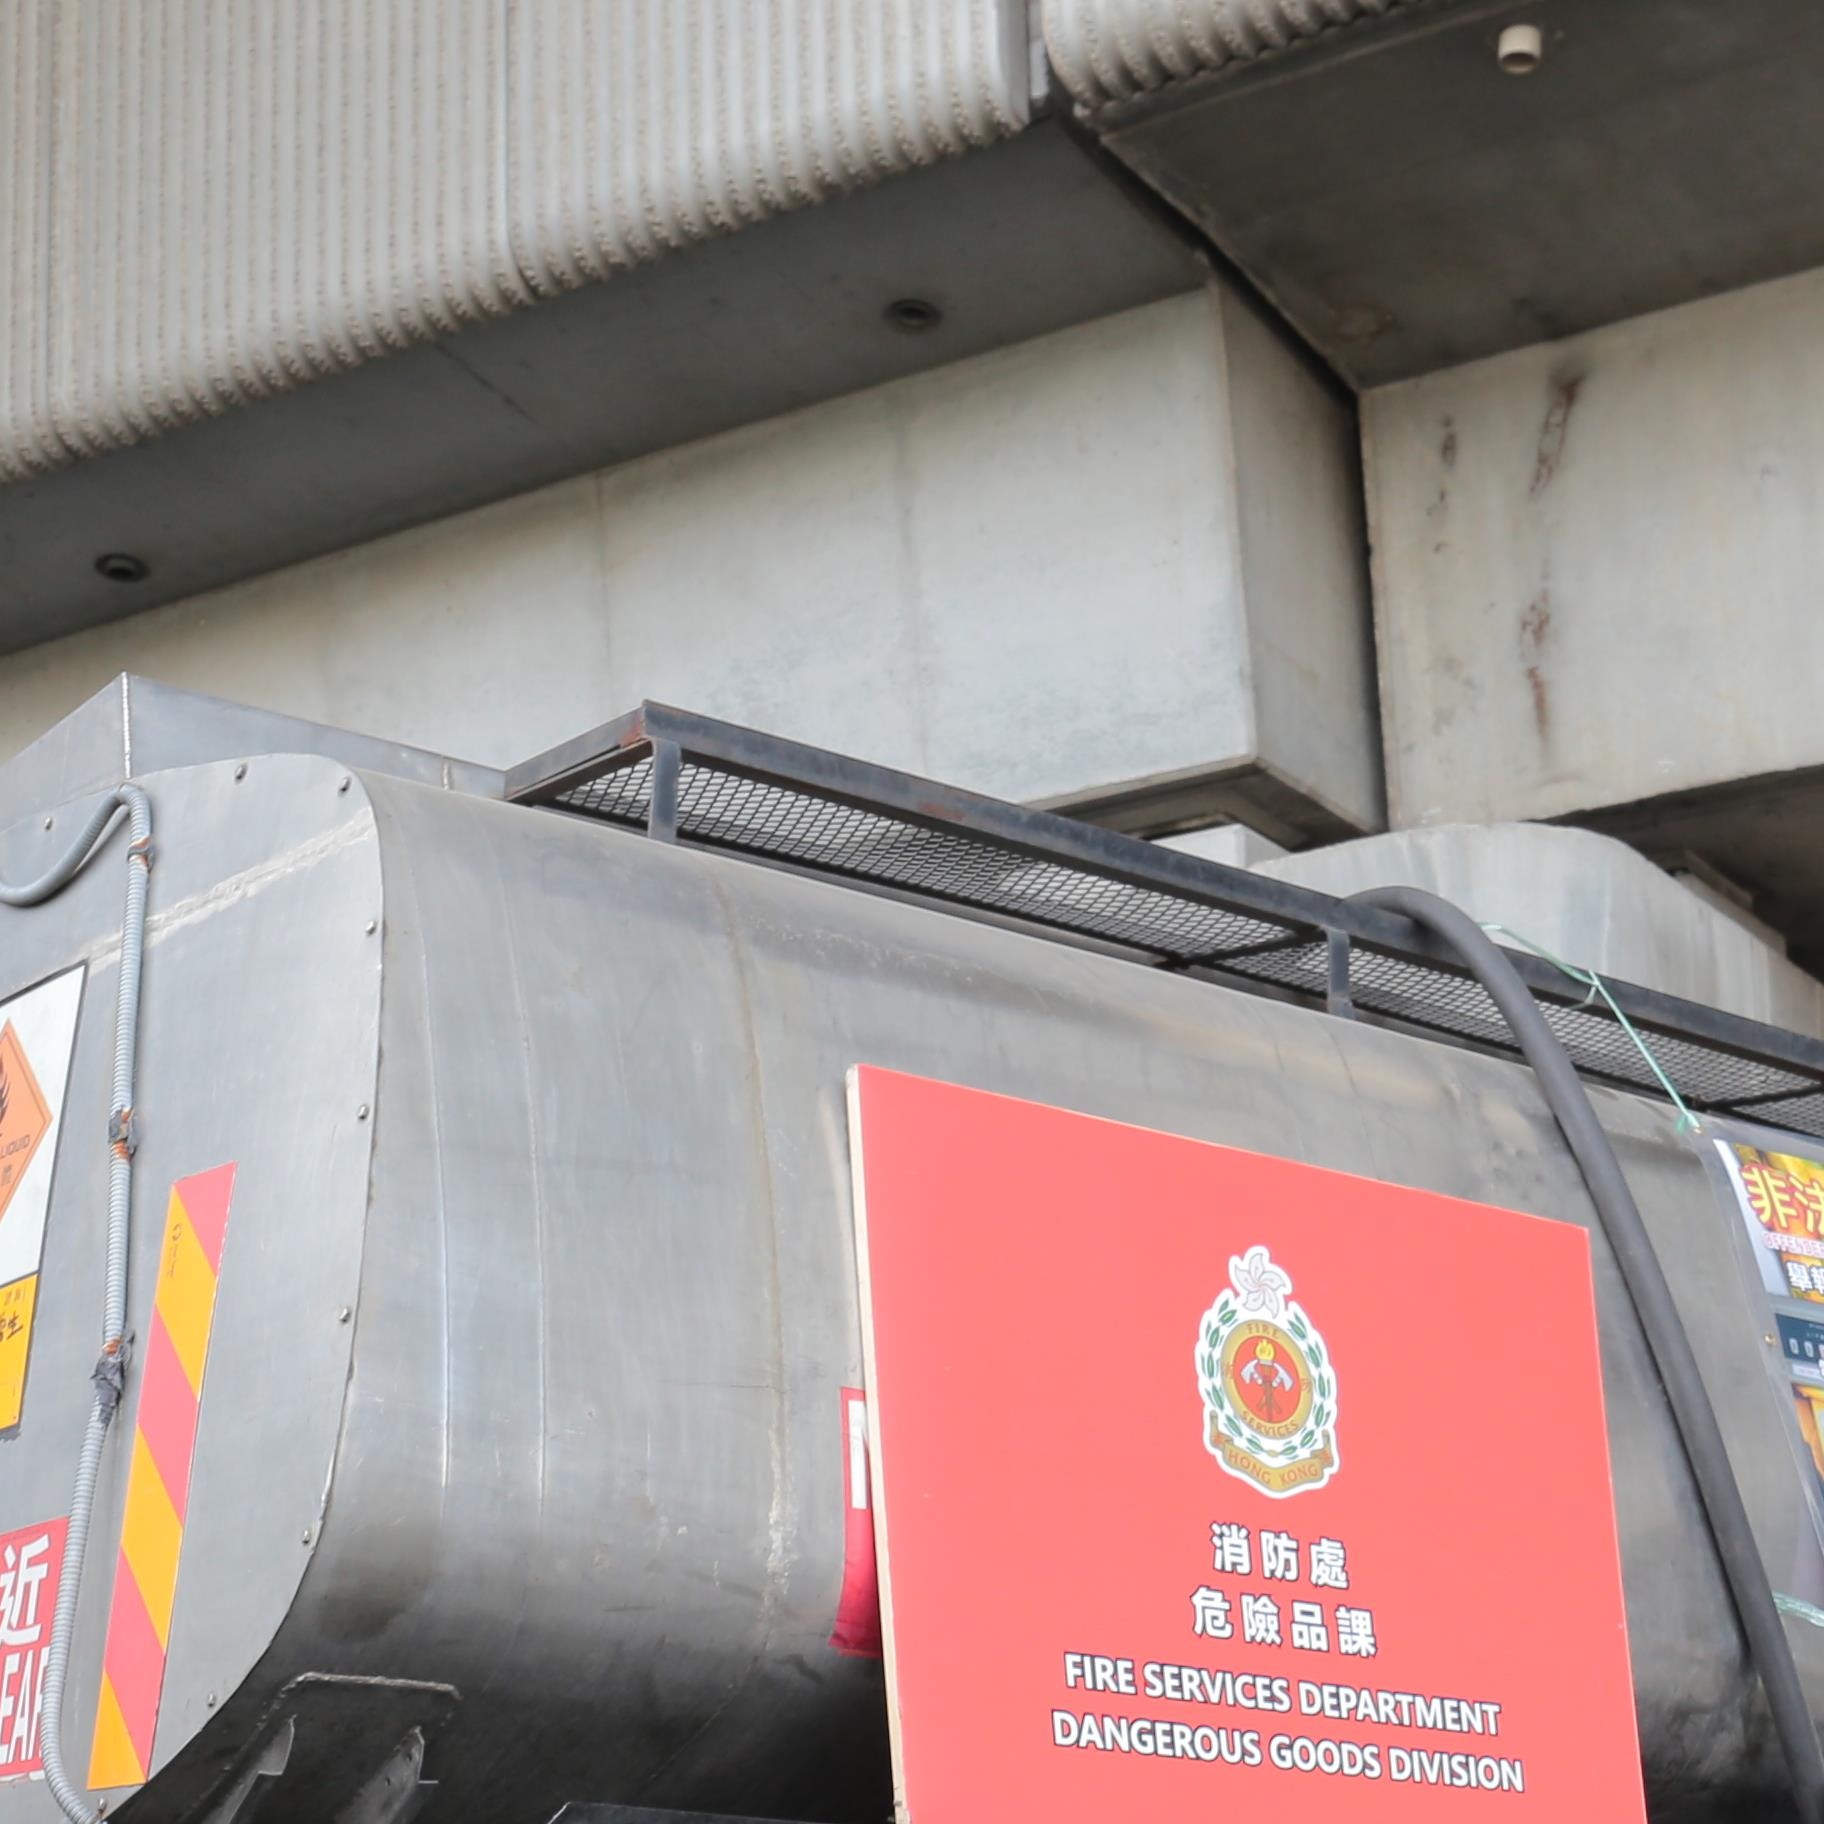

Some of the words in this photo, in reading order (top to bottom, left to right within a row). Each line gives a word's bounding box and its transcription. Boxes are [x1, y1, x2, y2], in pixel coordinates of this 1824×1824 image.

[0, 1134, 30, 1159] LIQUID
[1247, 1323, 1280, 1339] FIRE
[1243, 1410, 1299, 1438] SERVICES
[1228, 1449, 1272, 1485] HONG
[1280, 1463, 1318, 1487] KONG
[1210, 1520, 1350, 1589] 消防處
[1190, 1585, 1377, 1658] 危險品課
[1064, 1653, 1137, 1695] FIRE
[1143, 1659, 1291, 1713] SERVICES
[1298, 1681, 1501, 1736] DEPARTMENT
[1051, 1710, 1262, 1767] DANGEROUS
[1269, 1735, 1382, 1780] GOODS
[1388, 1747, 1525, 1793] DIVISION
